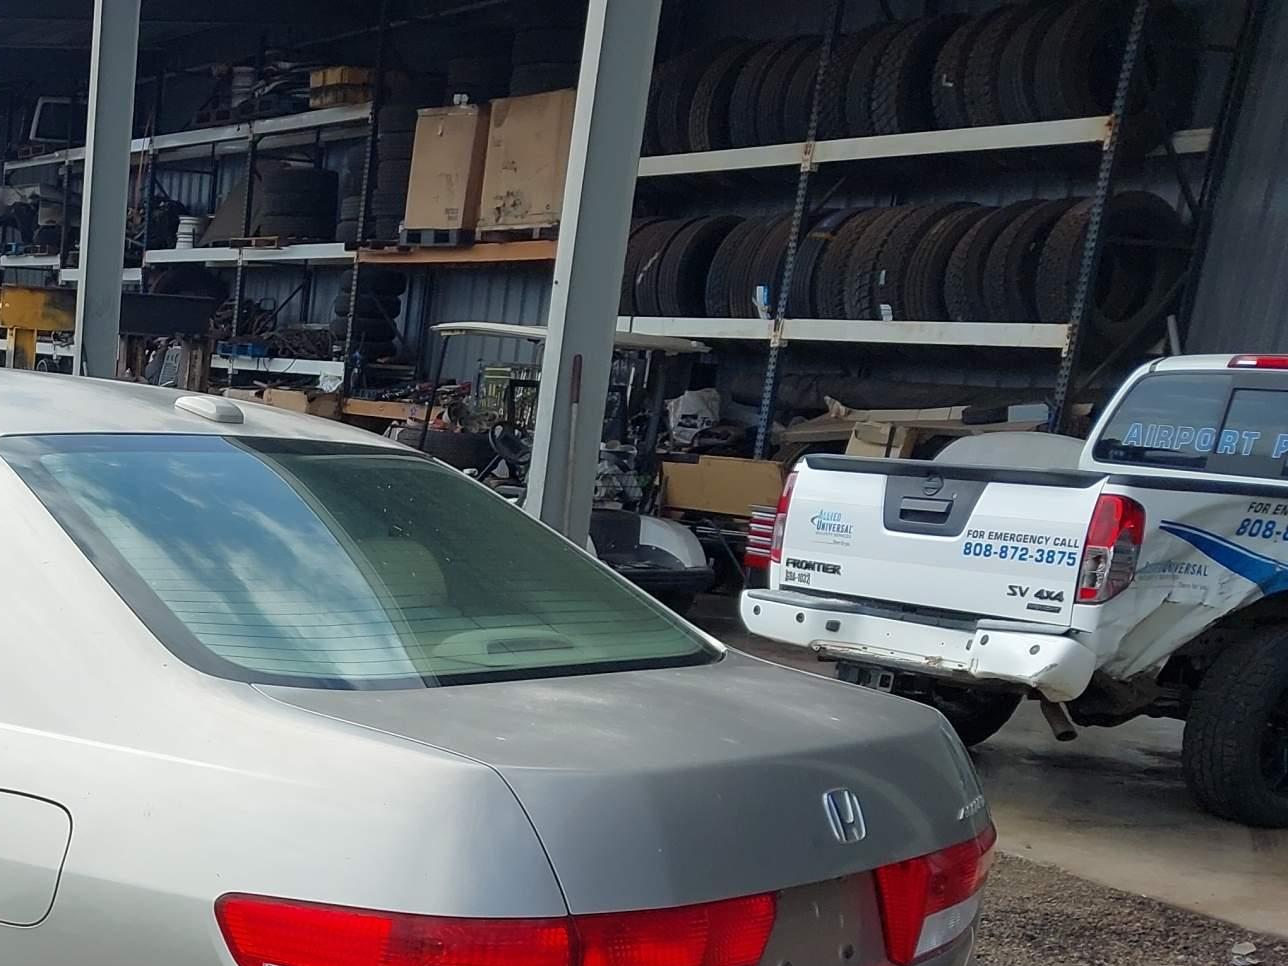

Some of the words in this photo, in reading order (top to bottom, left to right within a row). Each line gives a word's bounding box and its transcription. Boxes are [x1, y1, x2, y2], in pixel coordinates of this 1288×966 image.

[1122, 422, 1261, 456] AIRPORT
[818, 509, 842, 522] ALLIED
[1247, 502, 1272, 514] FOR
[816, 519, 853, 534] UNIVERSAL
[966, 529, 985, 540] FOR
[988, 531, 1052, 546] EMERGENCY
[1053, 537, 1080, 549] CALL
[963, 542, 1077, 567] 808-872-3875
[786, 557, 842, 576] FRONTIER
[1007, 585, 1030, 598] SV
